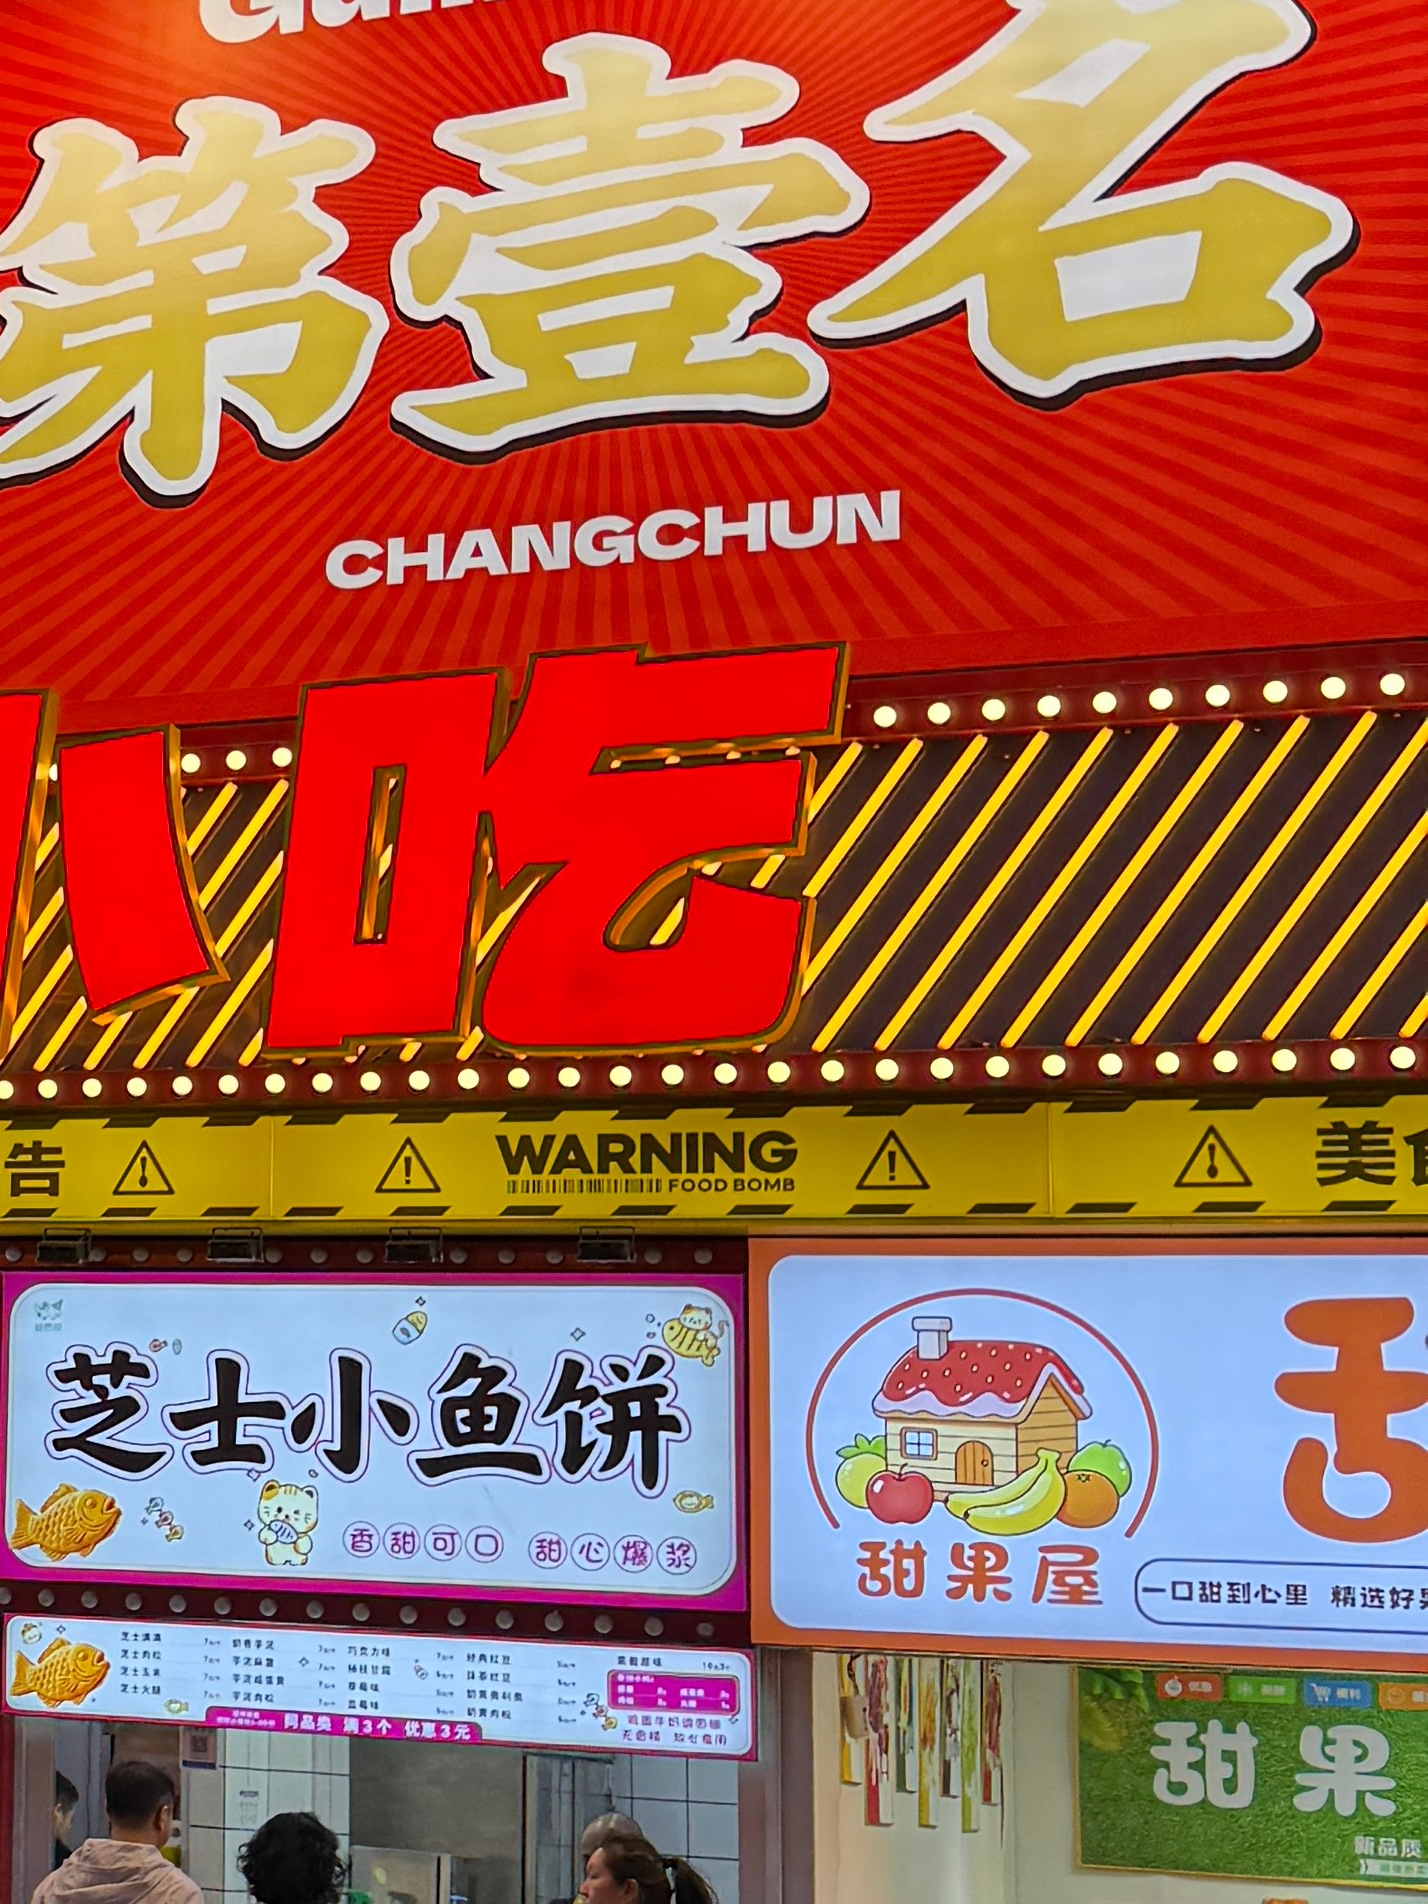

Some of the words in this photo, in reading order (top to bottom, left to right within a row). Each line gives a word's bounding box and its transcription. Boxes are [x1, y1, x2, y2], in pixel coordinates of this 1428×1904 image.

[324, 490, 900, 592] CHANGCHUN
[495, 1130, 798, 1176] WARNING
[669, 1179, 727, 1192] FOOD
[734, 1178, 795, 1192] BOMB
[50, 1350, 686, 1494] 芝士小鱼饼
[346, 1525, 500, 1559] 香甜可口
[532, 1535, 694, 1572] 甜心爆浆
[856, 1539, 1104, 1606] 甜果屋
[1141, 1580, 1308, 1606] 一口甜到心里
[1149, 1718, 1397, 1817] 甜果
